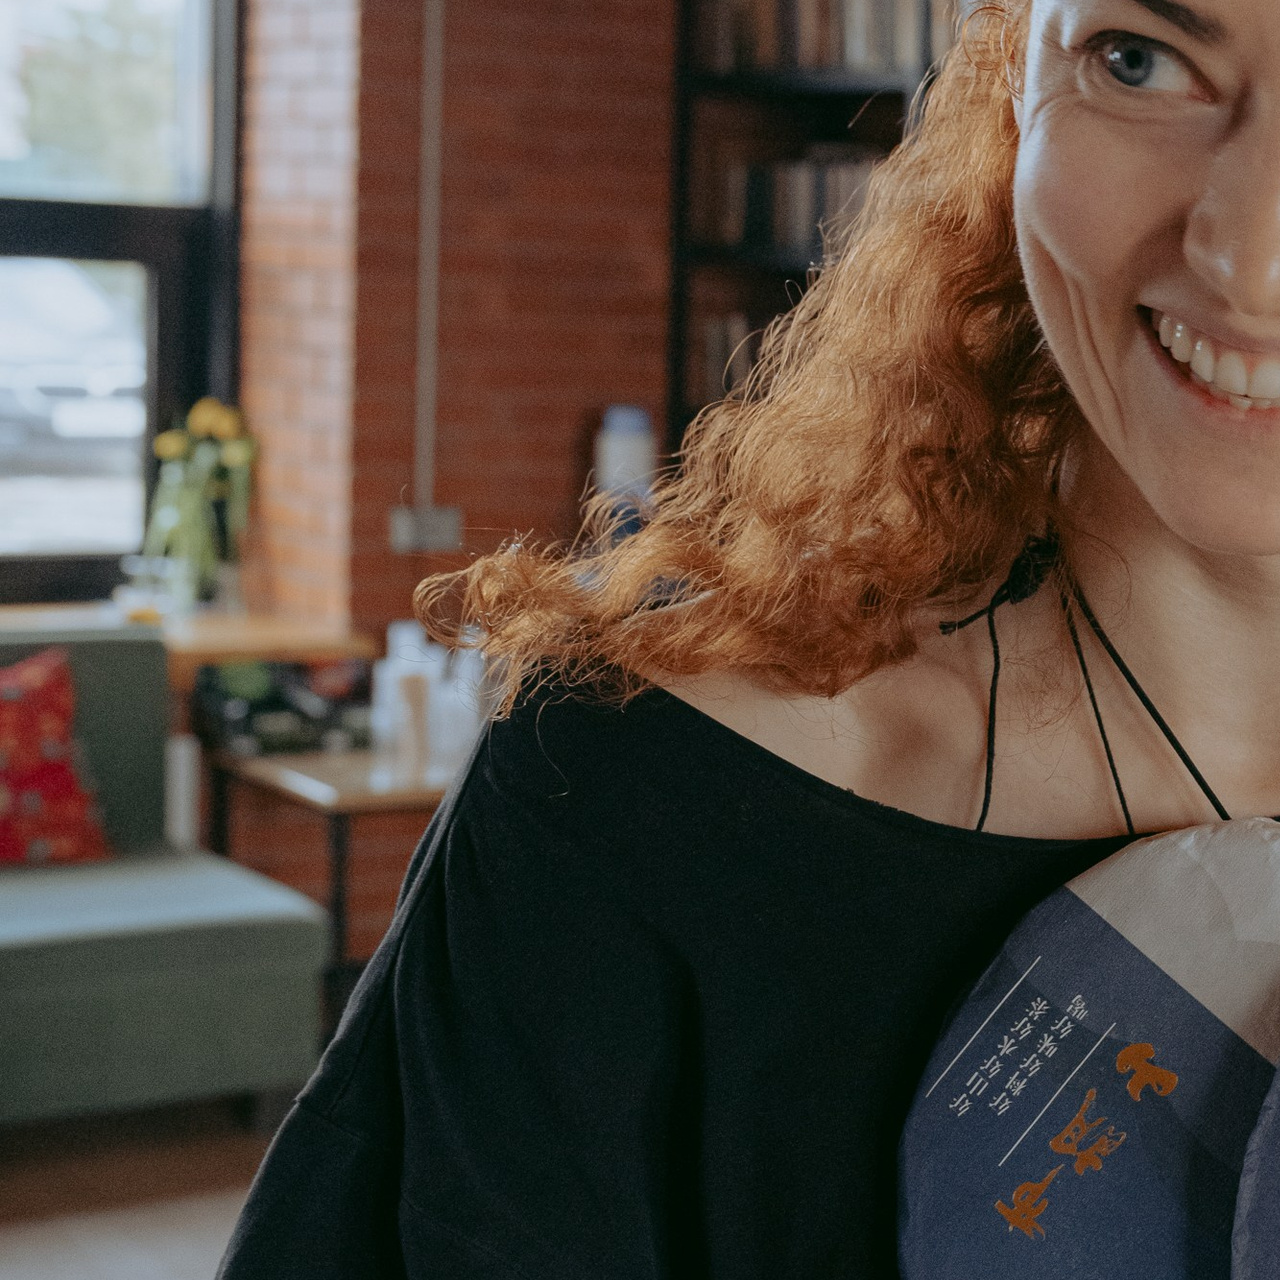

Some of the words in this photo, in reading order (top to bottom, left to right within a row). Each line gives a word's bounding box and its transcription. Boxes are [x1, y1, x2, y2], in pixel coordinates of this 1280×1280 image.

[949, 995, 1048, 1117] 好山好水好茶
[987, 992, 1090, 1117] 好料好味好喝
[994, 1042, 1180, 1240] 布朗山
